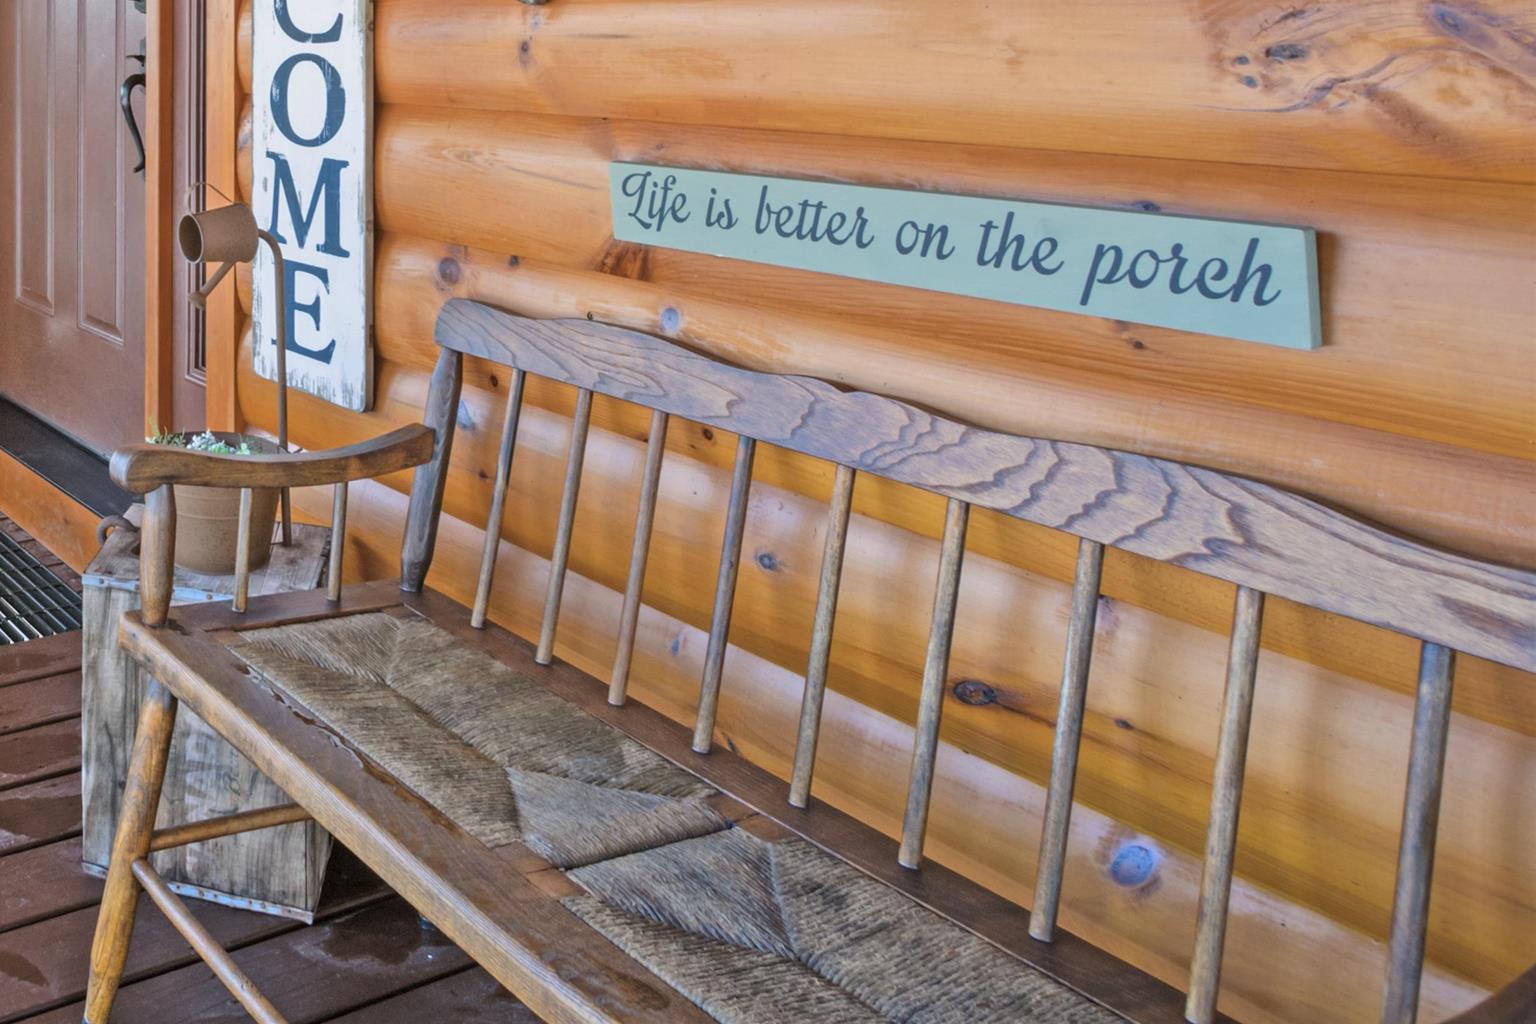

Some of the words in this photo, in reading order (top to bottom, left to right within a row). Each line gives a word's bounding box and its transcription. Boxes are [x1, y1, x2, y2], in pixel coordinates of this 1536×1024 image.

[621, 171, 691, 232] Life
[705, 188, 739, 230] is
[755, 184, 875, 250] better
[895, 220, 956, 261] on
[976, 211, 1065, 275] the
[1079, 237, 1282, 307] porch
